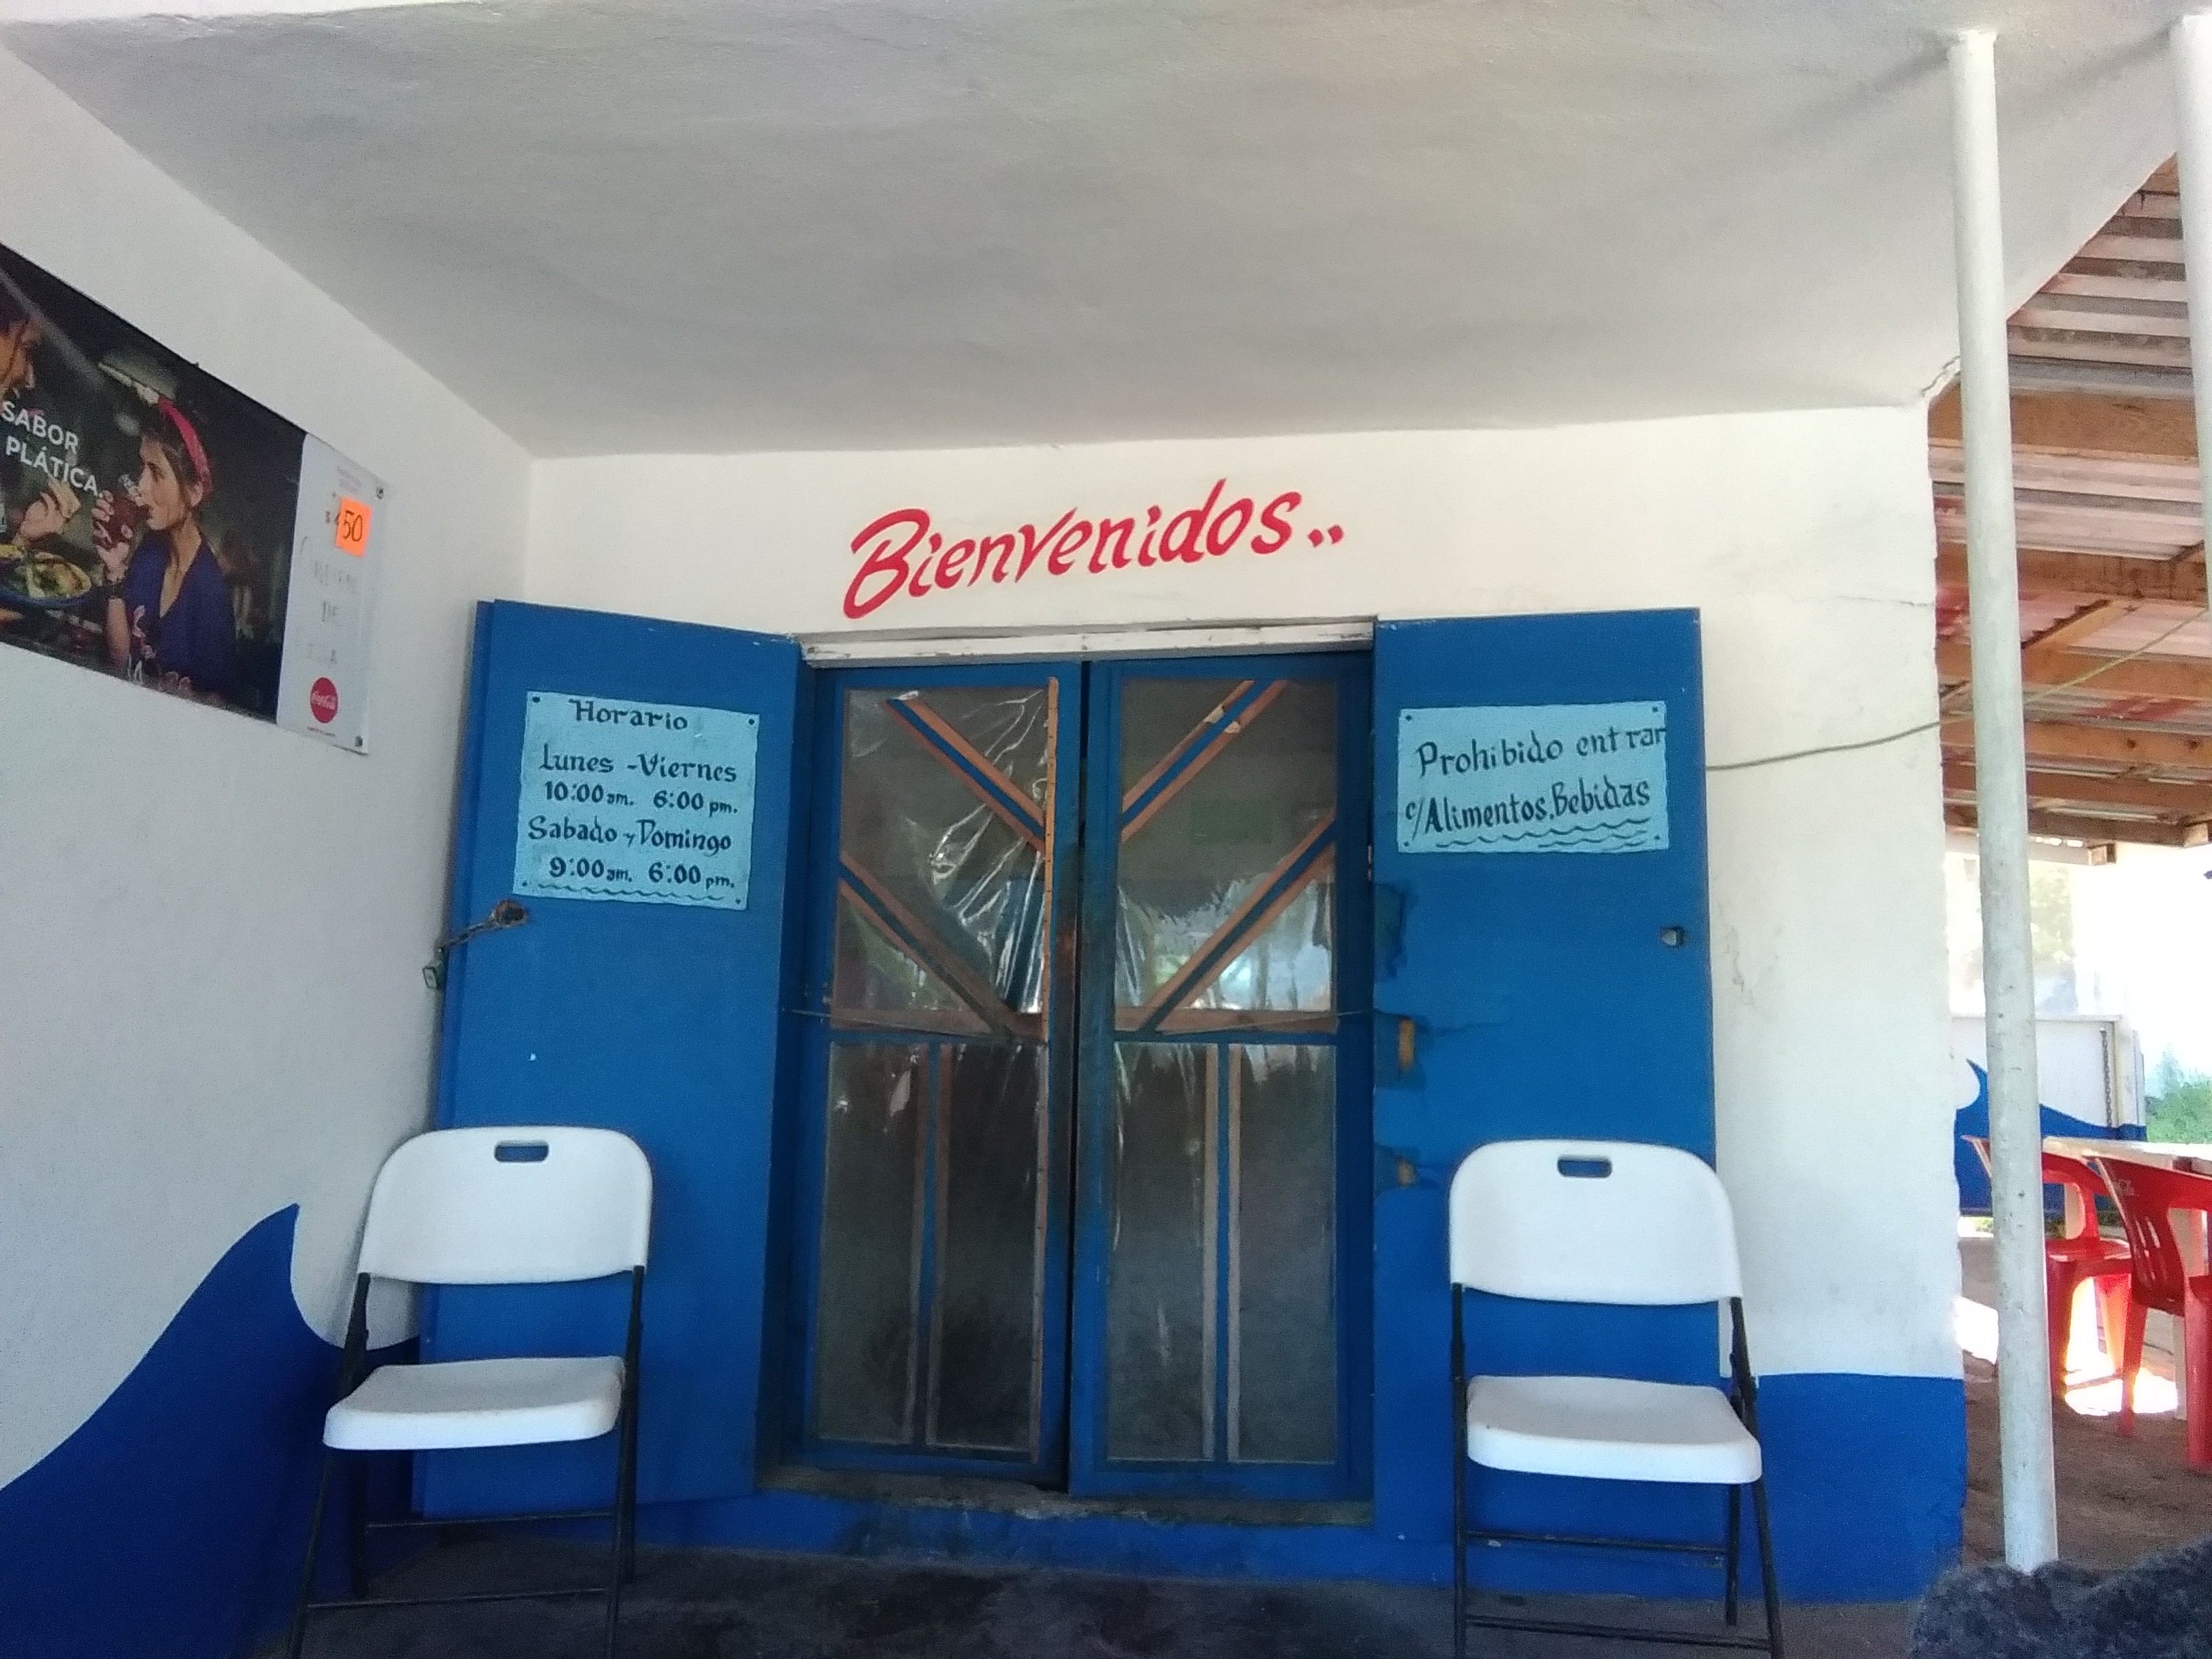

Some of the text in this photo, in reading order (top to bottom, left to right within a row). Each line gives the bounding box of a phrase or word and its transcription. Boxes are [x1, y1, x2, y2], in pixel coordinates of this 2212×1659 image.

[1, 401, 79, 455] SABOR
[344, 510, 363, 542] 50
[568, 698, 689, 731] Horario
[539, 743, 615, 774] Lunes
[1416, 726, 1666, 778] Prohibido entrar
[528, 815, 733, 857] Sabado y Domingo
